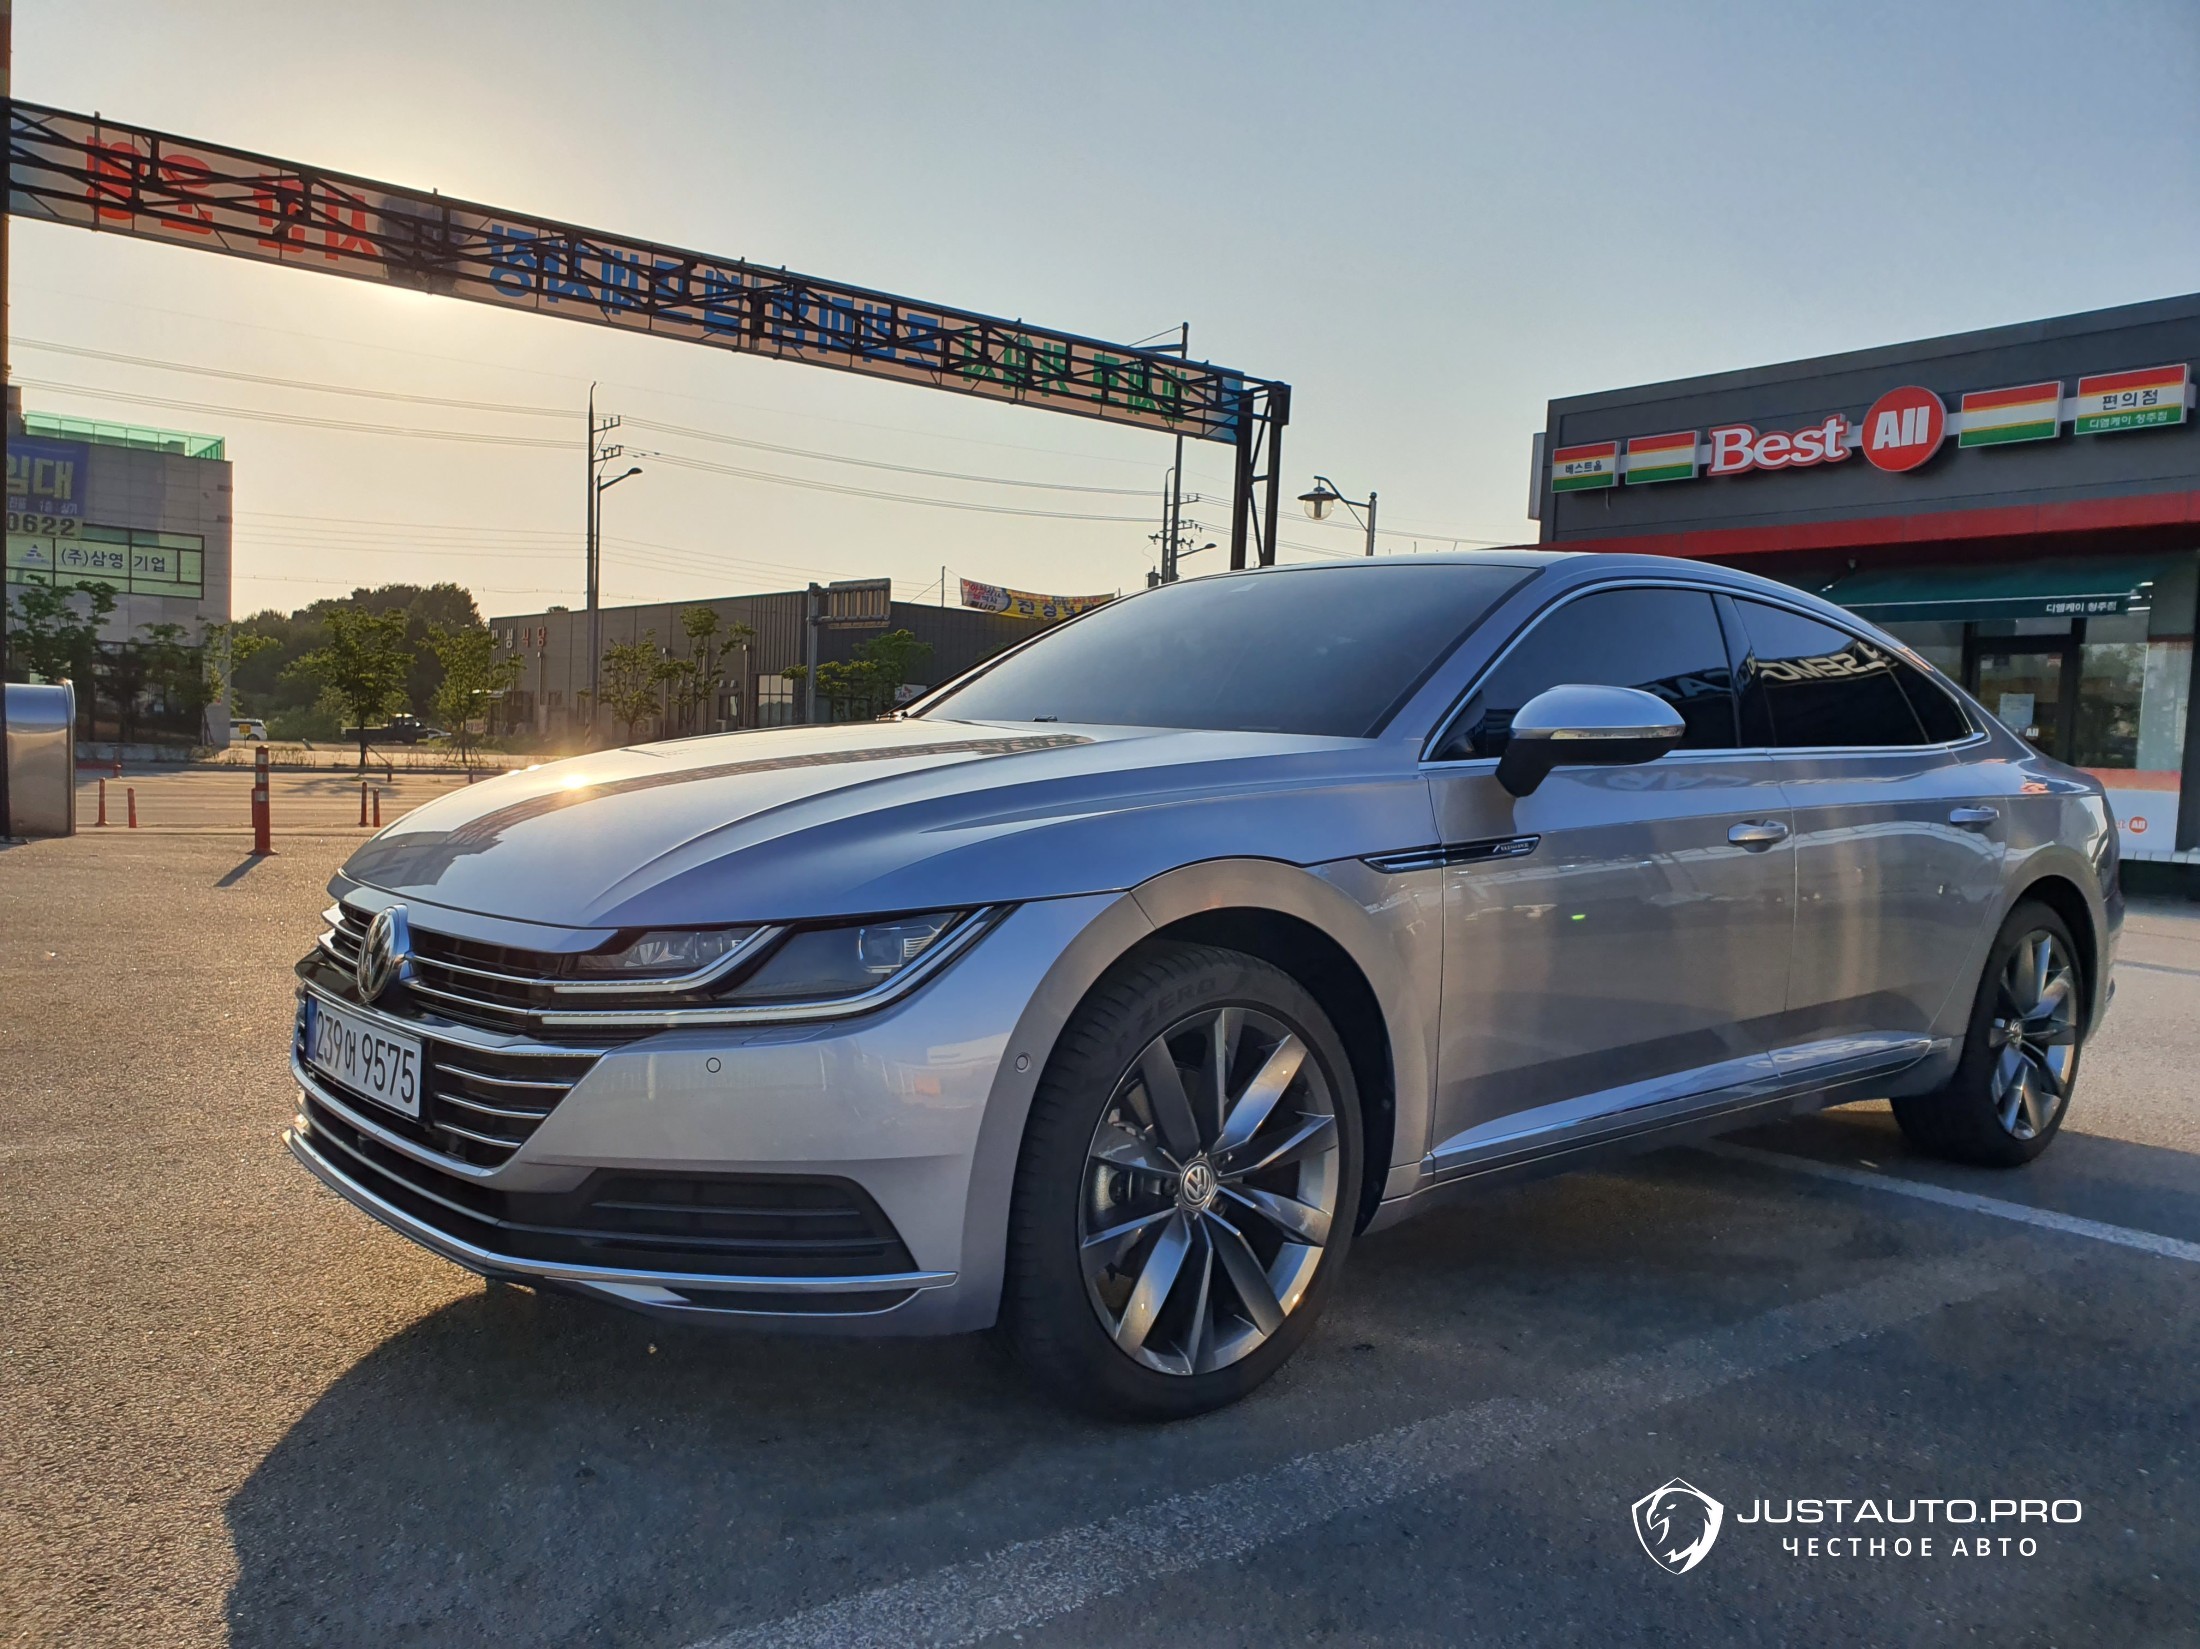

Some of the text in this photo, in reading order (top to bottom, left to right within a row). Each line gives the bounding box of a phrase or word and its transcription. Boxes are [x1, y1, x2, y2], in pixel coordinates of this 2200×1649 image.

[2102, 389, 2159, 411] 편의점
[1711, 405, 1931, 473] Best All
[7, 512, 76, 536] 0622
[61, 547, 124, 570] (주)삼영
[133, 555, 166, 573] 기업
[316, 1010, 415, 1105] 239어 9575
